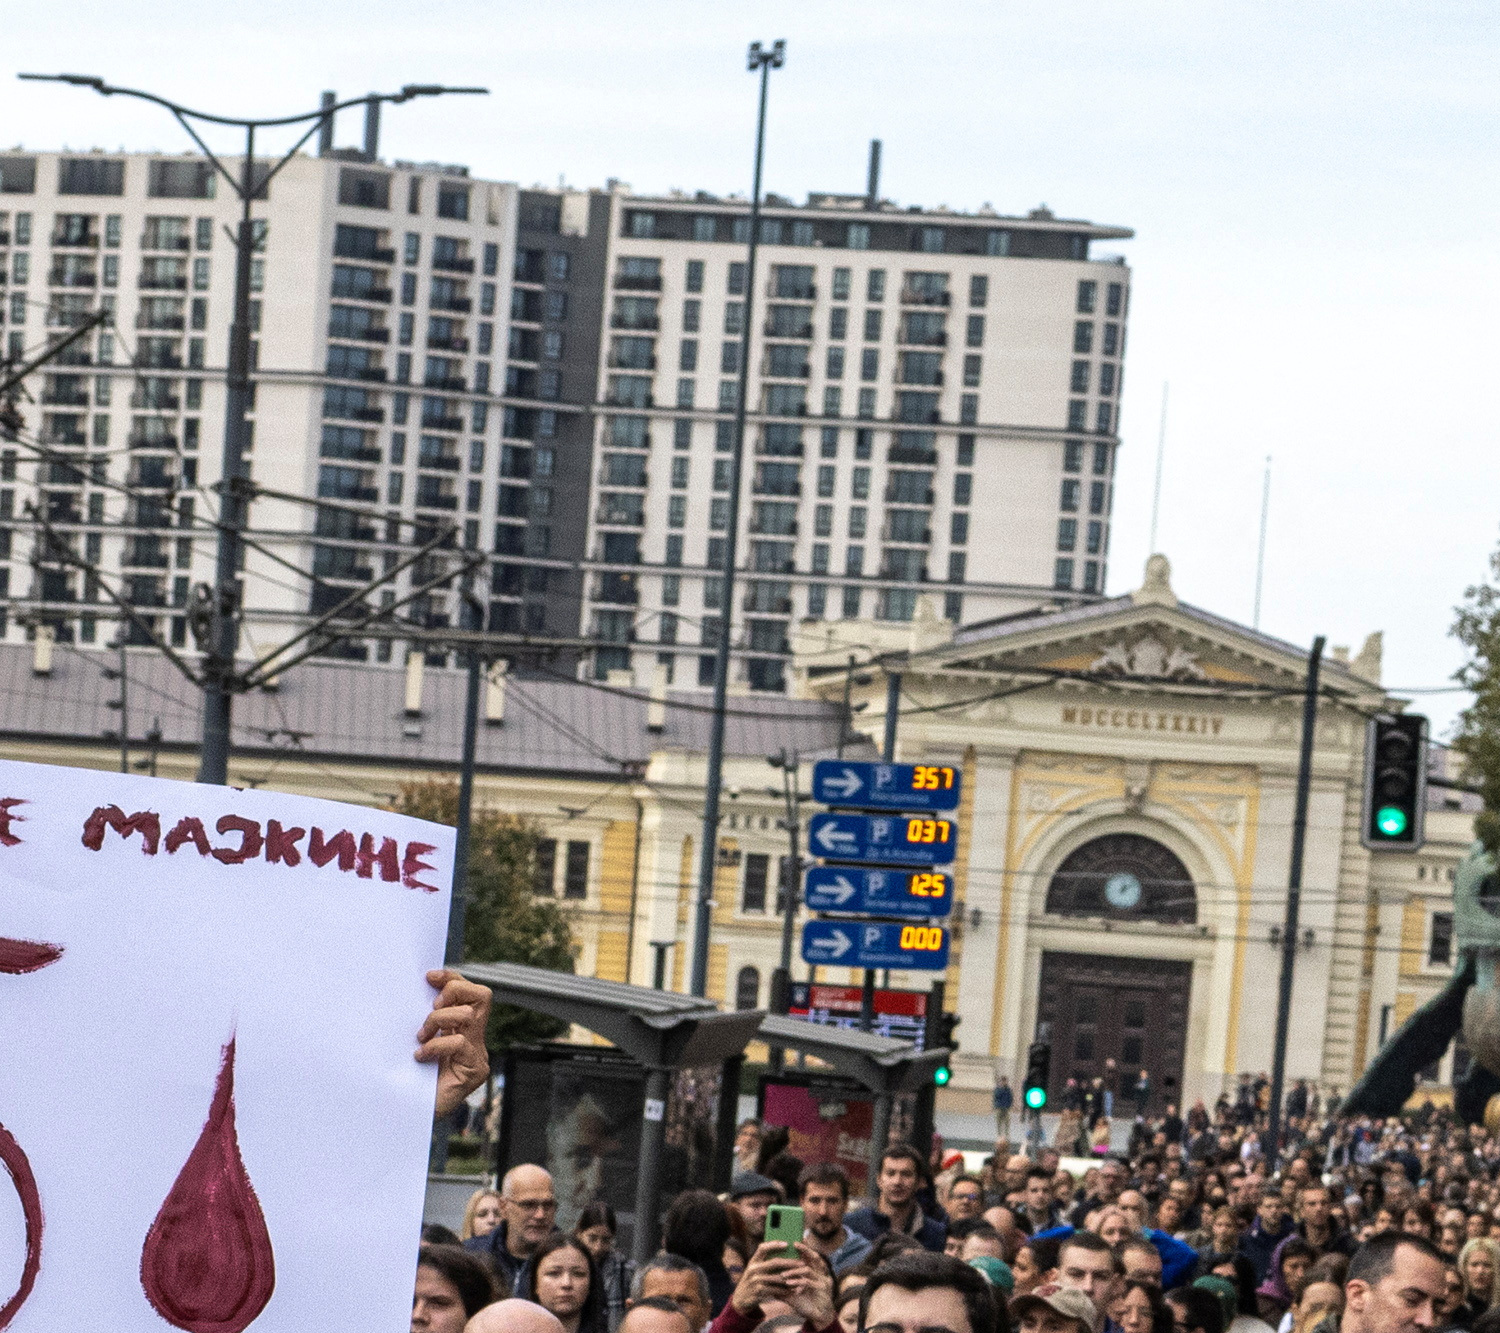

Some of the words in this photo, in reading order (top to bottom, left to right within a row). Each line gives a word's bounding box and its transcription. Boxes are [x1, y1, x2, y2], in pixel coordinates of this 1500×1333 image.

[1061, 707, 1224, 735] MDCCCLXXXIV
[911, 765, 955, 790] 357
[906, 819, 950, 843] 037
[83, 801, 440, 893] МАЈКИНЕ
[910, 873, 946, 897] 125
[899, 926, 943, 951] 000
